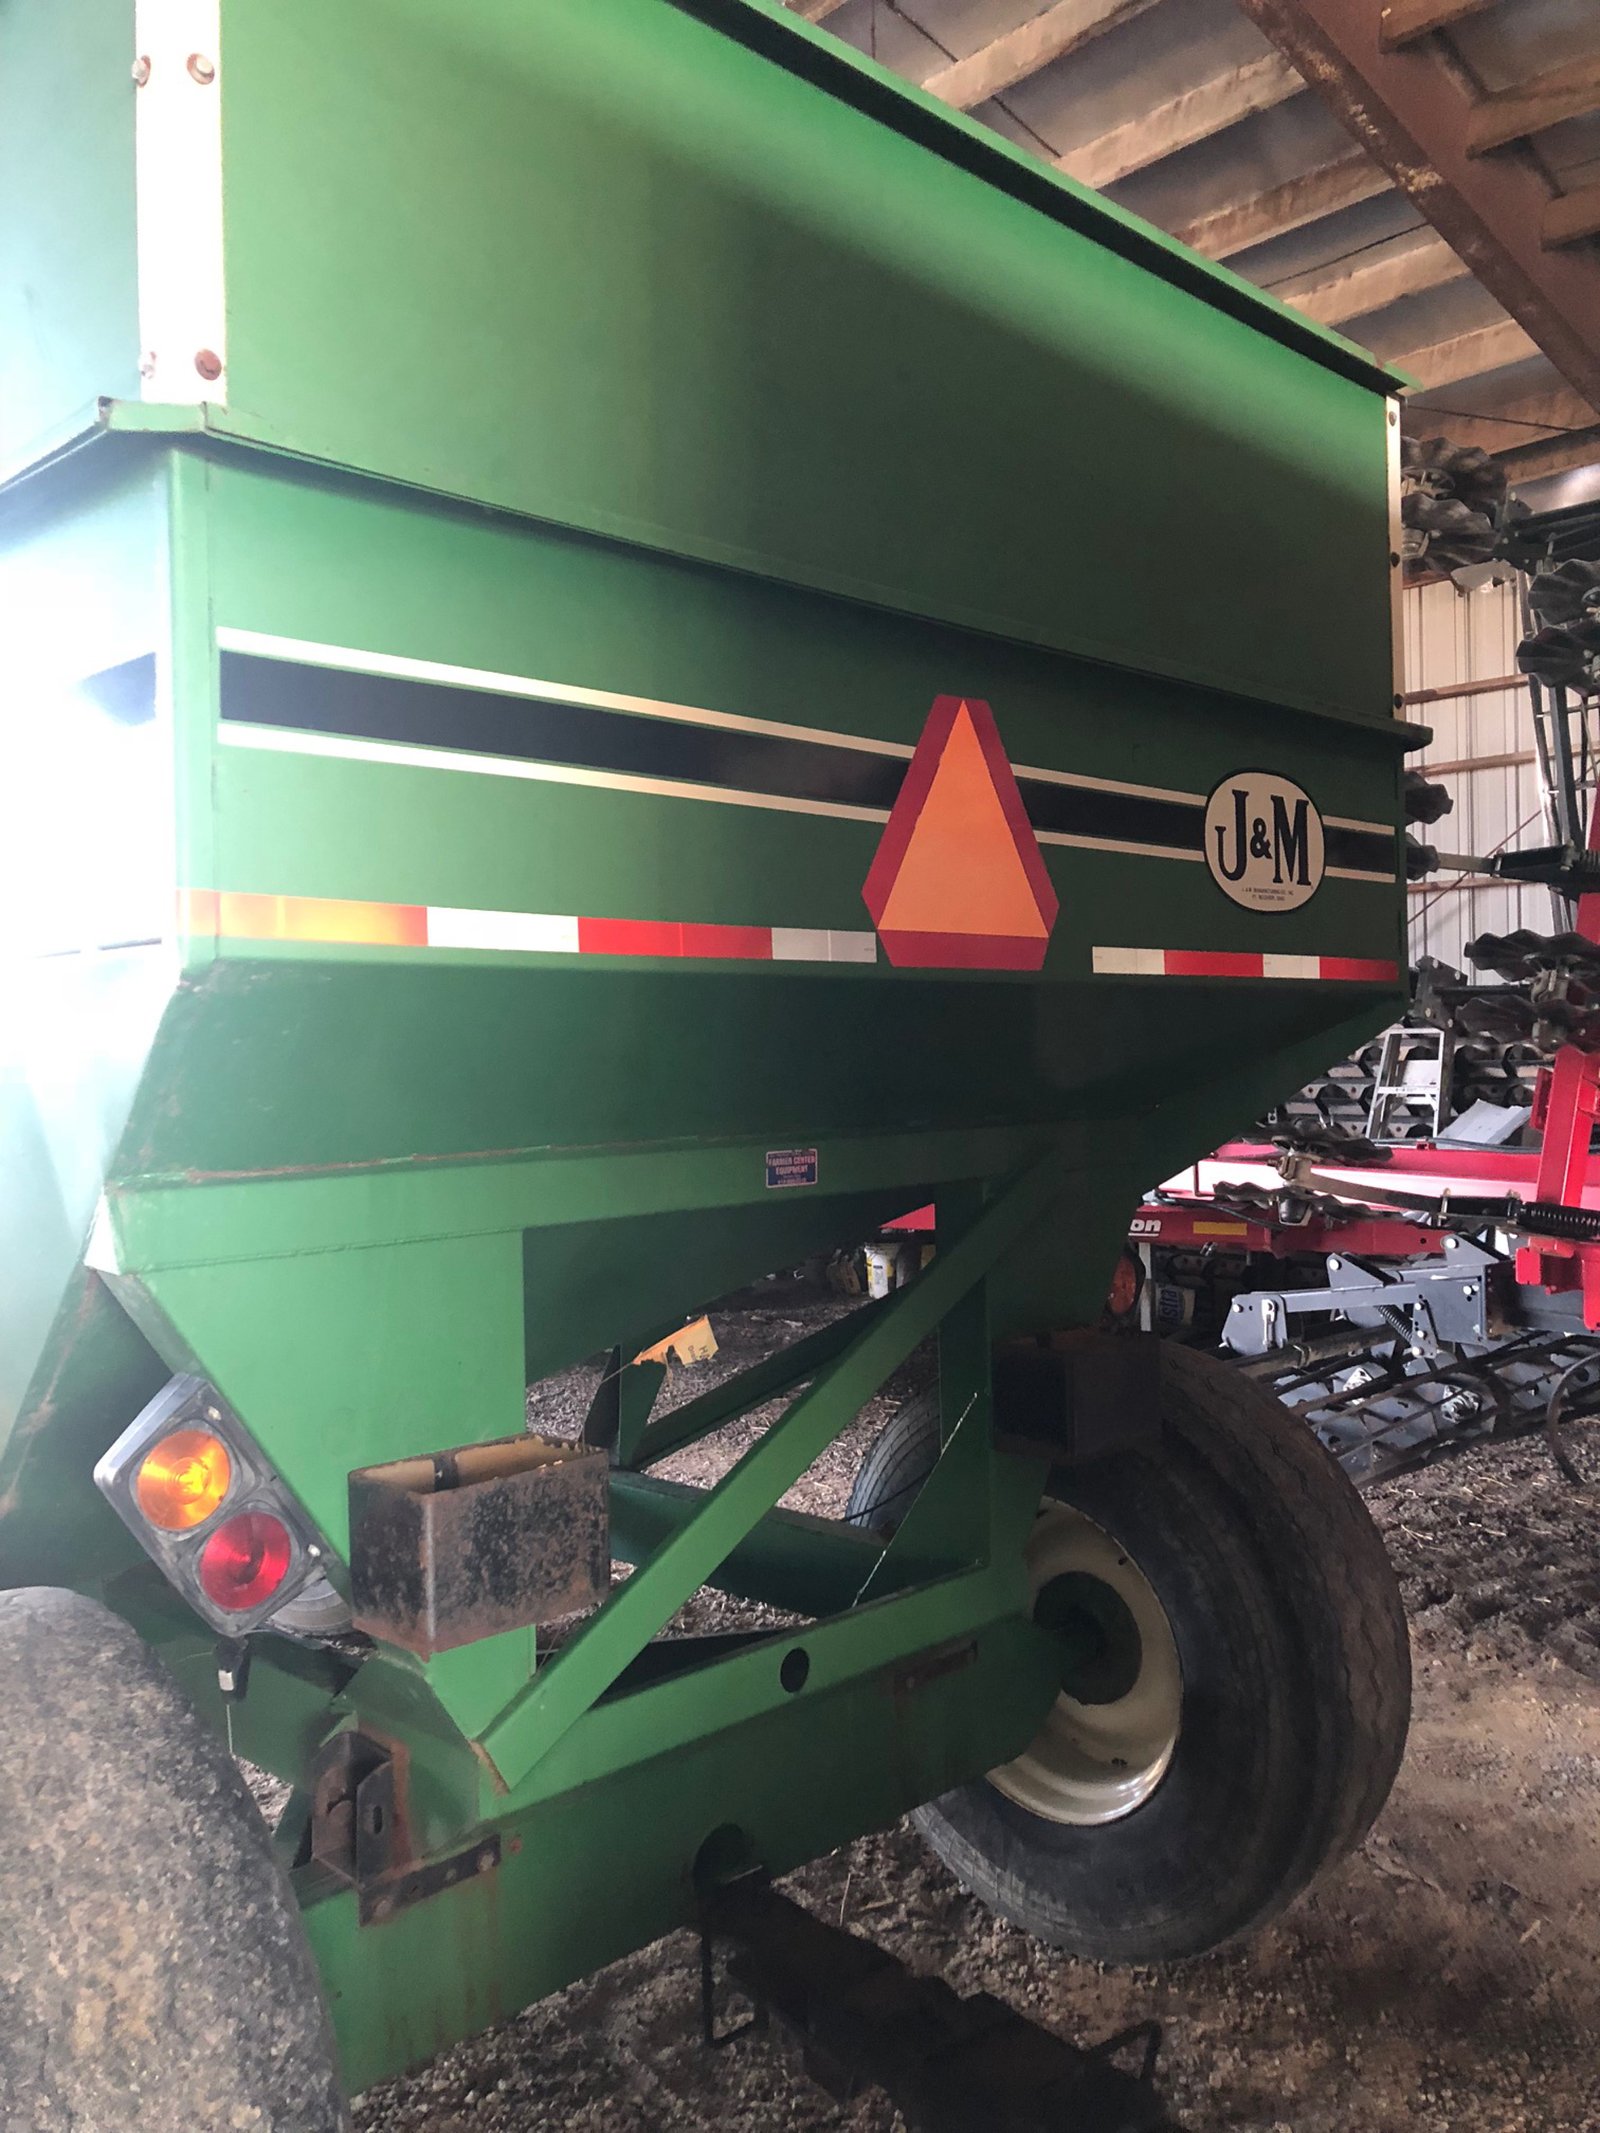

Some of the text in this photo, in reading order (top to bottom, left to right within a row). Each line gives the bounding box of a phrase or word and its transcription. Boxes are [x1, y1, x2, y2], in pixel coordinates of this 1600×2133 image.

[1214, 789, 1312, 886] J&M
[793, 1155, 816, 1165] CENTER
[776, 1165, 808, 1175] EQUIPMENT
